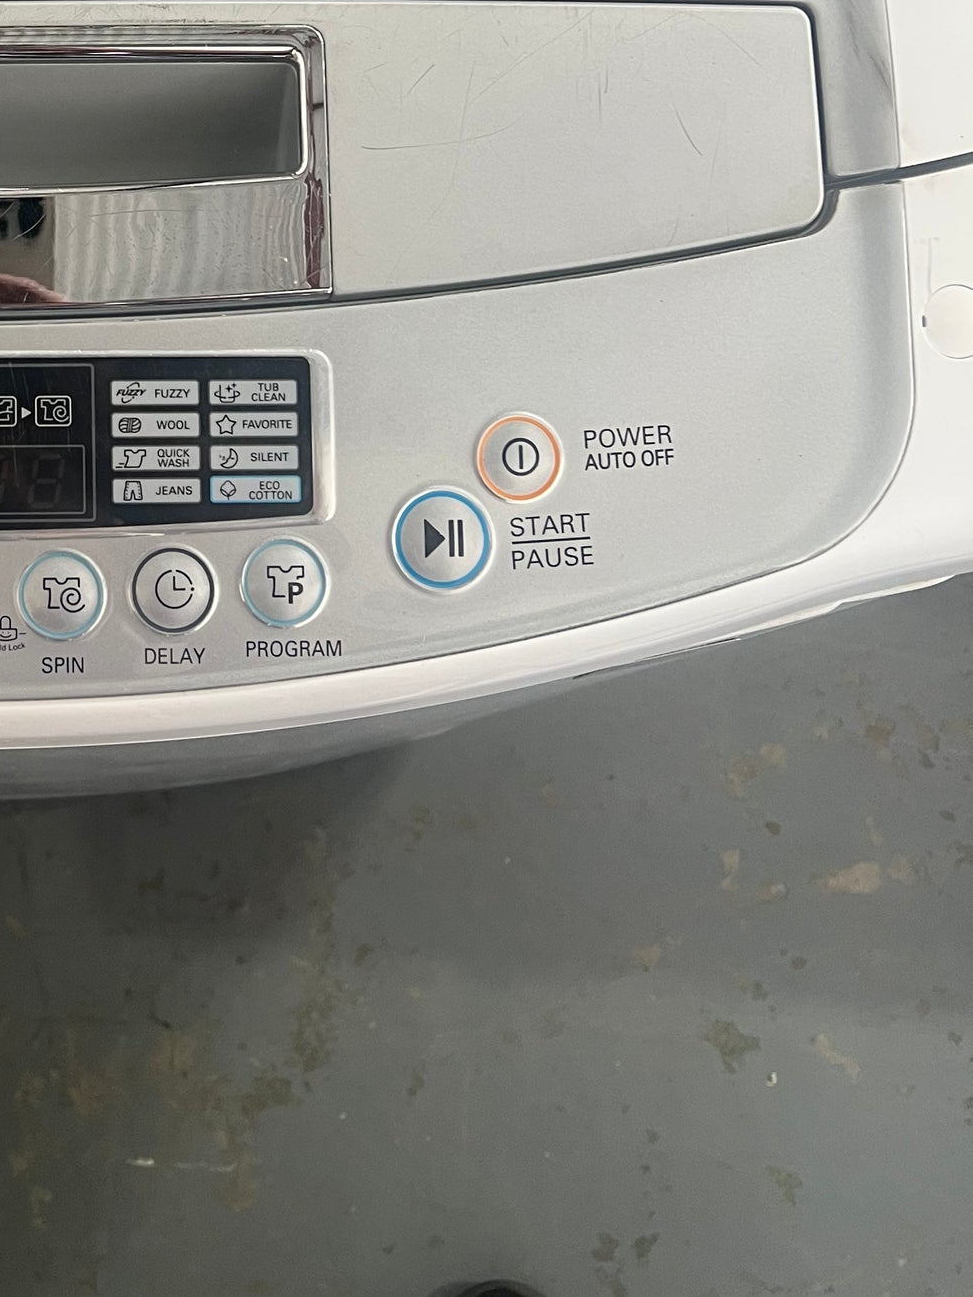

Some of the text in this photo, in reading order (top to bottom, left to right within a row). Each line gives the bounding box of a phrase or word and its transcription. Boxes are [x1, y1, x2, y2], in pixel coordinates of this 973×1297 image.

[258, 383, 279, 391] TUB
[154, 389, 190, 398] FUZZY
[251, 393, 286, 402] CLEAN
[156, 420, 190, 430] WOOL
[242, 419, 292, 429] FAVORITE
[583, 424, 672, 449] POWER
[157, 449, 190, 458] QUICK
[250, 453, 289, 462] SILENT
[157, 459, 190, 468] WASH
[584, 448, 674, 471] AUTO OFF
[259, 481, 280, 490] ECO
[155, 486, 193, 496] JEANS
[248, 491, 293, 500] COTTON
[510, 513, 591, 537] START
[511, 546, 595, 570] PAUSE
[8, 642, 25, 651] Lock
[245, 640, 343, 657] PROGRAM
[144, 647, 205, 665] DELAY
[41, 657, 85, 674] SPIN
